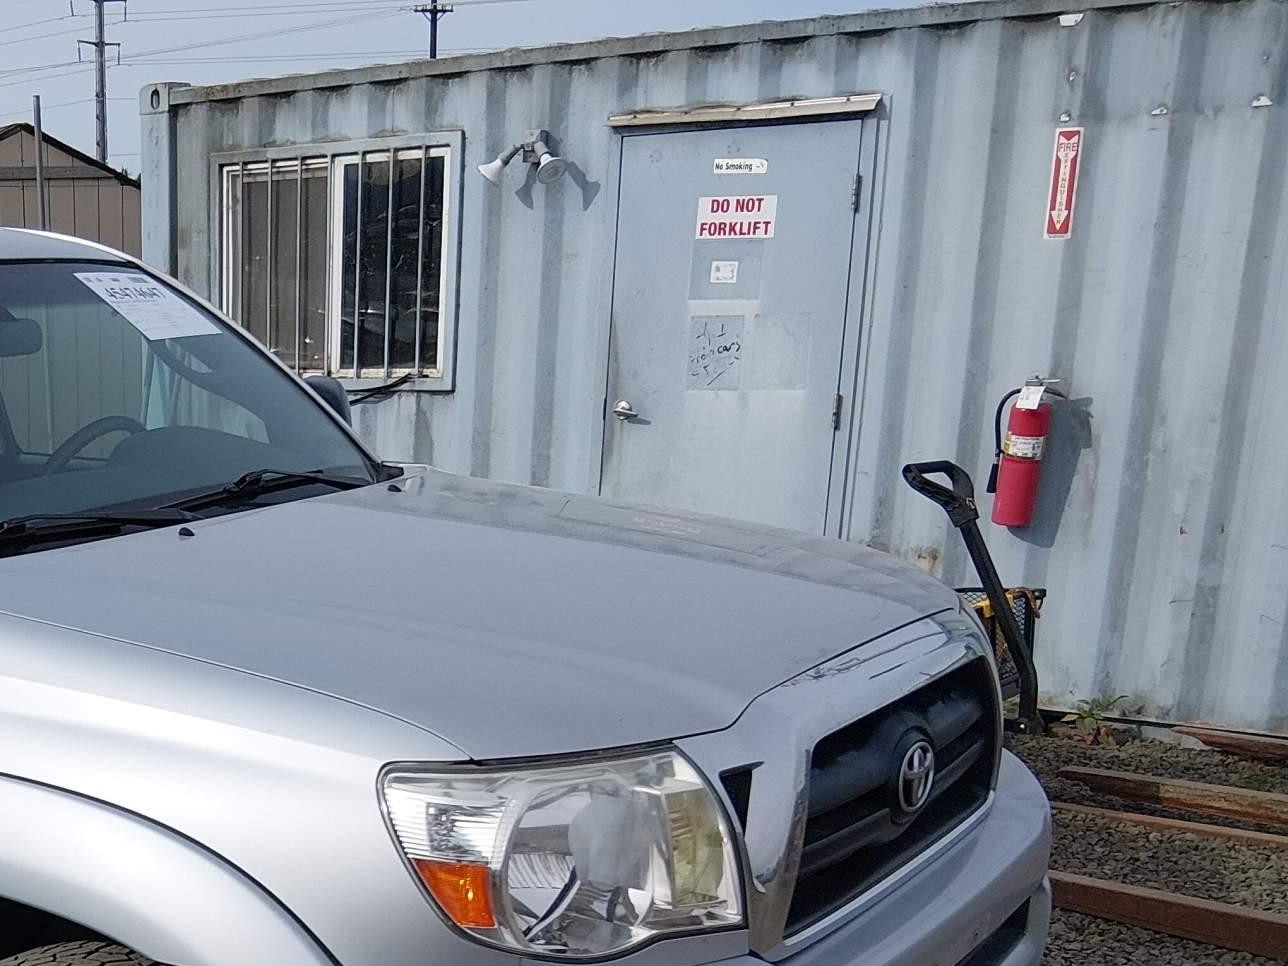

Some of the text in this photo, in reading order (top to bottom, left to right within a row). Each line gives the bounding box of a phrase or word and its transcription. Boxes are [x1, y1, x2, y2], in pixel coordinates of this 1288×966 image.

[1058, 142, 1078, 152] FIRE
[715, 162, 753, 172] No Smoking
[710, 198, 765, 213] DO NOT
[699, 221, 772, 237] FORKLIFT
